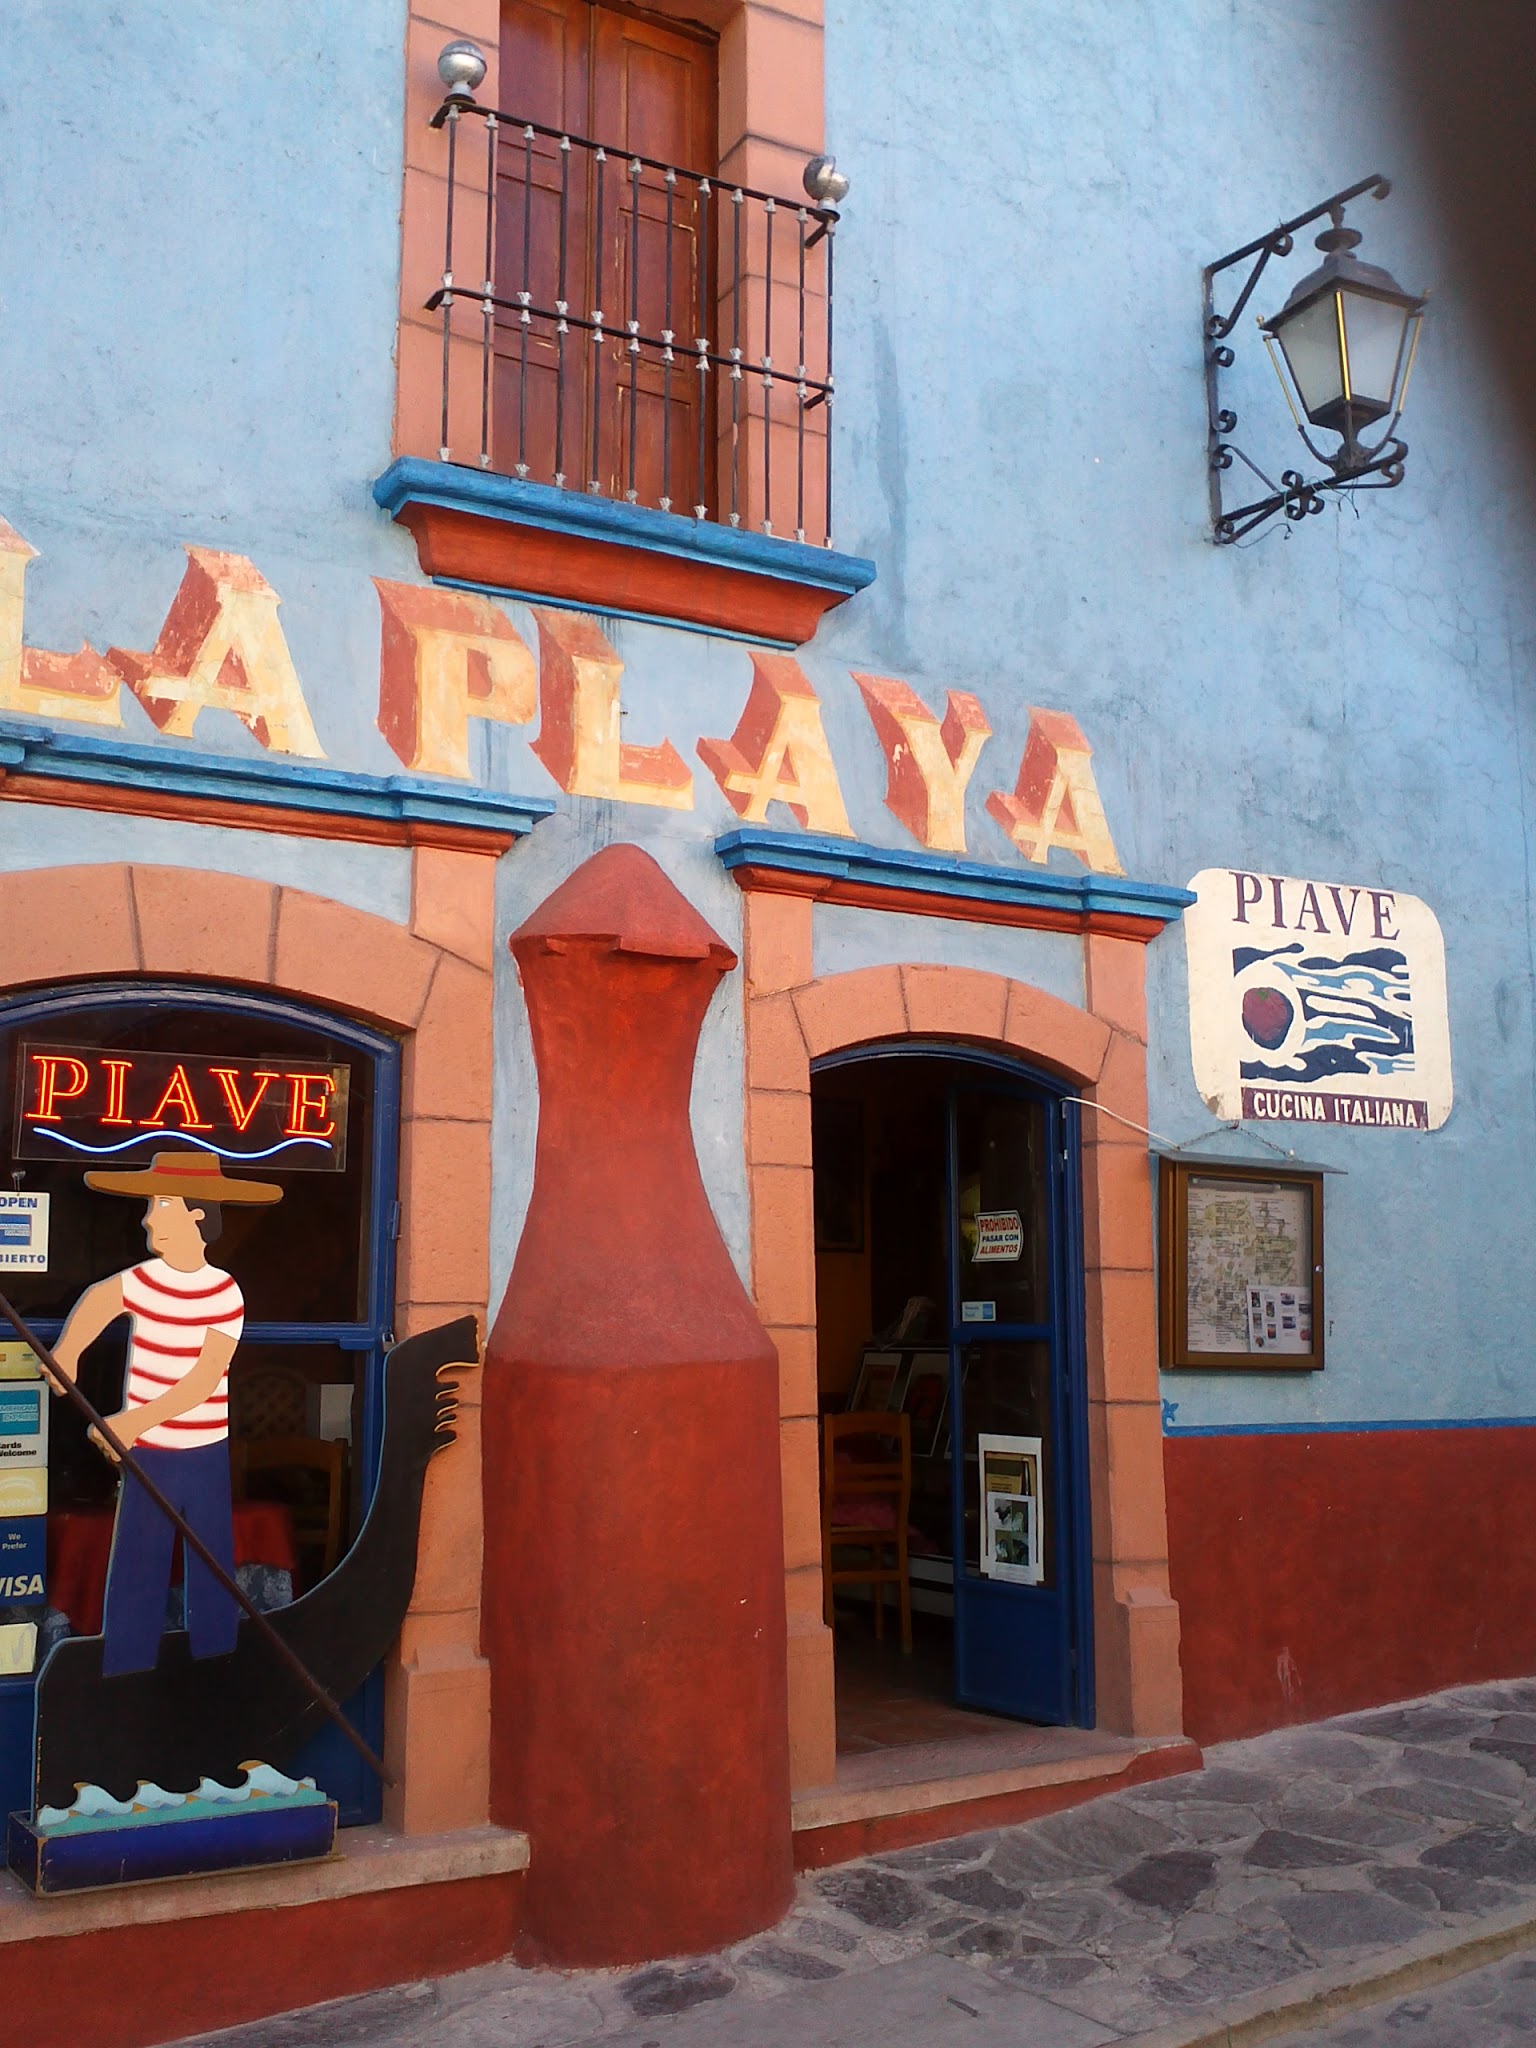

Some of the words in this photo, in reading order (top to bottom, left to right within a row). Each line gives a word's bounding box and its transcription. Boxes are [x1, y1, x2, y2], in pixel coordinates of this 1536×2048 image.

[370, 576, 1127, 877] PLAYA
[1229, 871, 1400, 940] PIAVE
[25, 1055, 338, 1138] PIAVE
[1253, 1092, 1326, 1121] CUCINA
[1333, 1098, 1417, 1127] ITALIANA
[0, 1196, 38, 1208] OPEN
[979, 1217, 1019, 1232] PROHIBIDO
[980, 1244, 1018, 1255] ALIMENTOS
[2, 1542, 28, 1550] Prefer
